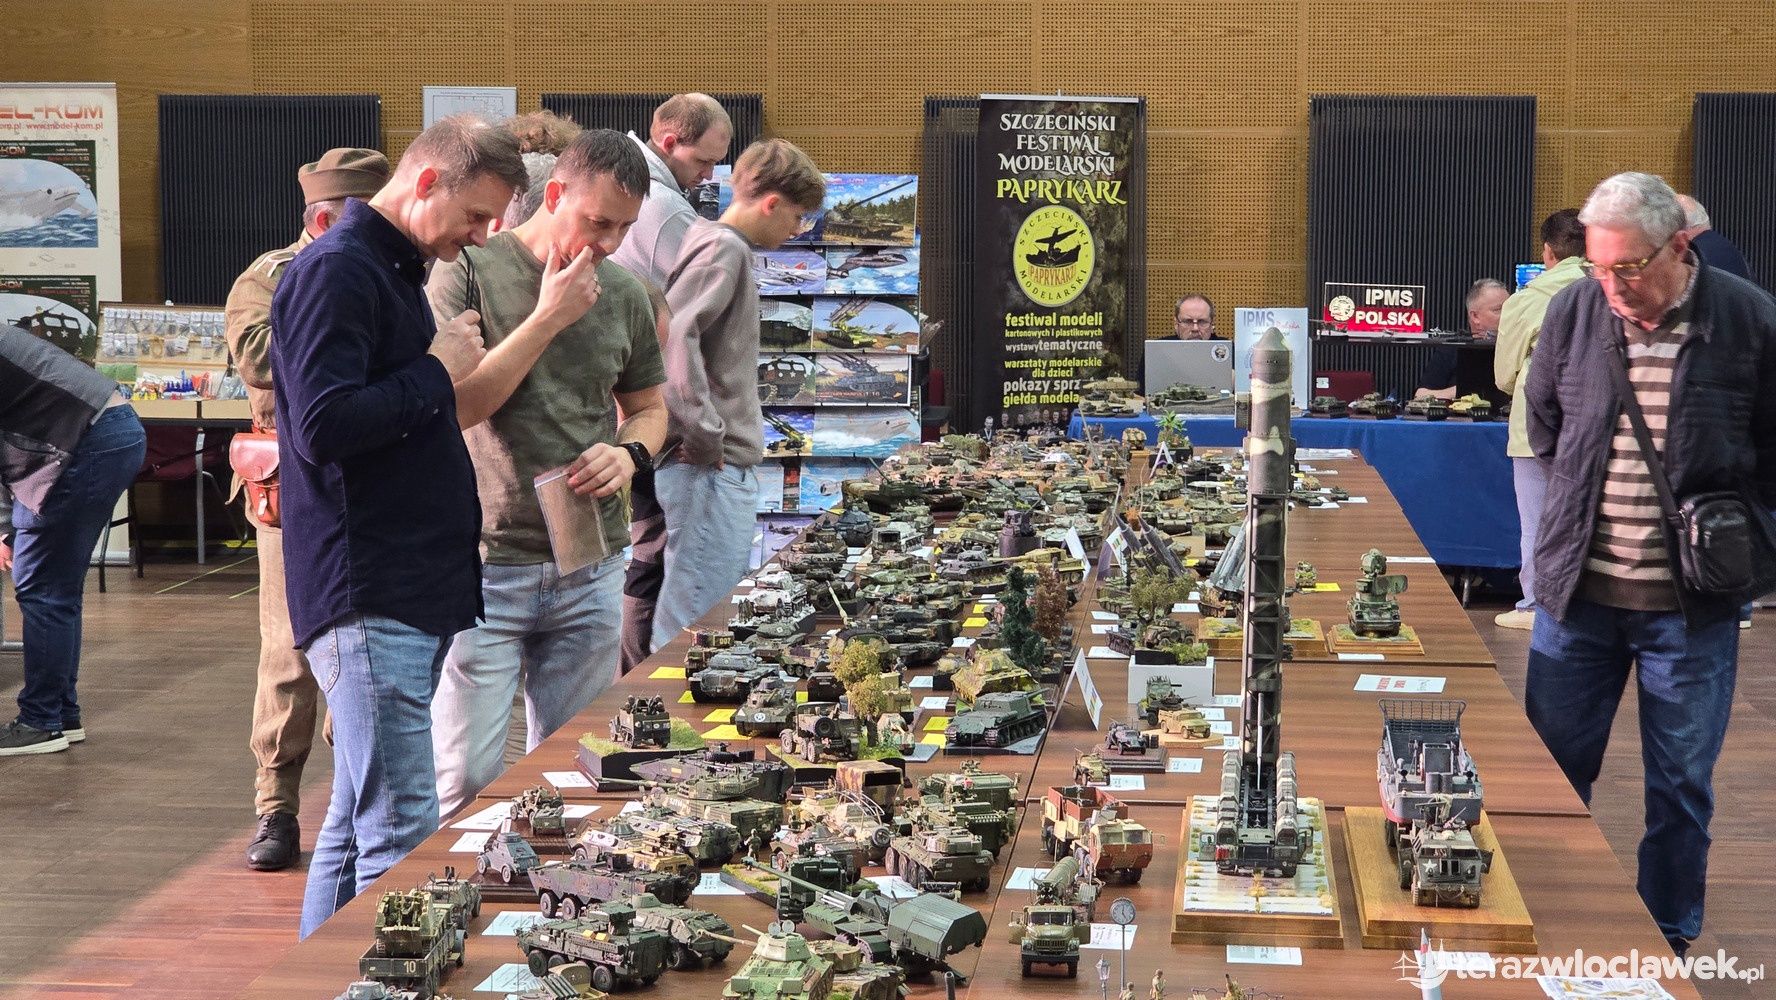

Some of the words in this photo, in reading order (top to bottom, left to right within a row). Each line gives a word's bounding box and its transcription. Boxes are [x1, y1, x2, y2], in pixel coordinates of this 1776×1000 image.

[1000, 112, 1116, 131] SZCZECIŃSKI
[1016, 131, 1110, 156] FESTIWAL
[998, 153, 1115, 175] MODELARSKI
[996, 178, 1127, 204] PAPRYKARZ
[1019, 211, 1089, 246] SZCZECIŃSKI
[1019, 269, 1088, 300] MODELARSKI
[1029, 267, 1076, 287] PAPRYKARZ
[1365, 289, 1413, 307] IPMS
[1005, 313, 1056, 327] festiwal
[1060, 312, 1103, 326] modeli
[1243, 311, 1275, 327] IPMS
[1355, 311, 1421, 326] POLSKA
[1005, 329, 1050, 338] kartonowych
[1055, 329, 1103, 338] plastikowych
[1038, 339, 1103, 353] tematyczne
[1005, 358, 1047, 369] warsztaty
[1049, 357, 1102, 367] modelarskie
[1032, 368, 1045, 378] dla
[1047, 367, 1073, 378] dzieci
[1003, 377, 1051, 395] pokazy
[1003, 393, 1037, 408] giełda
[403, 960, 416, 973] 10
